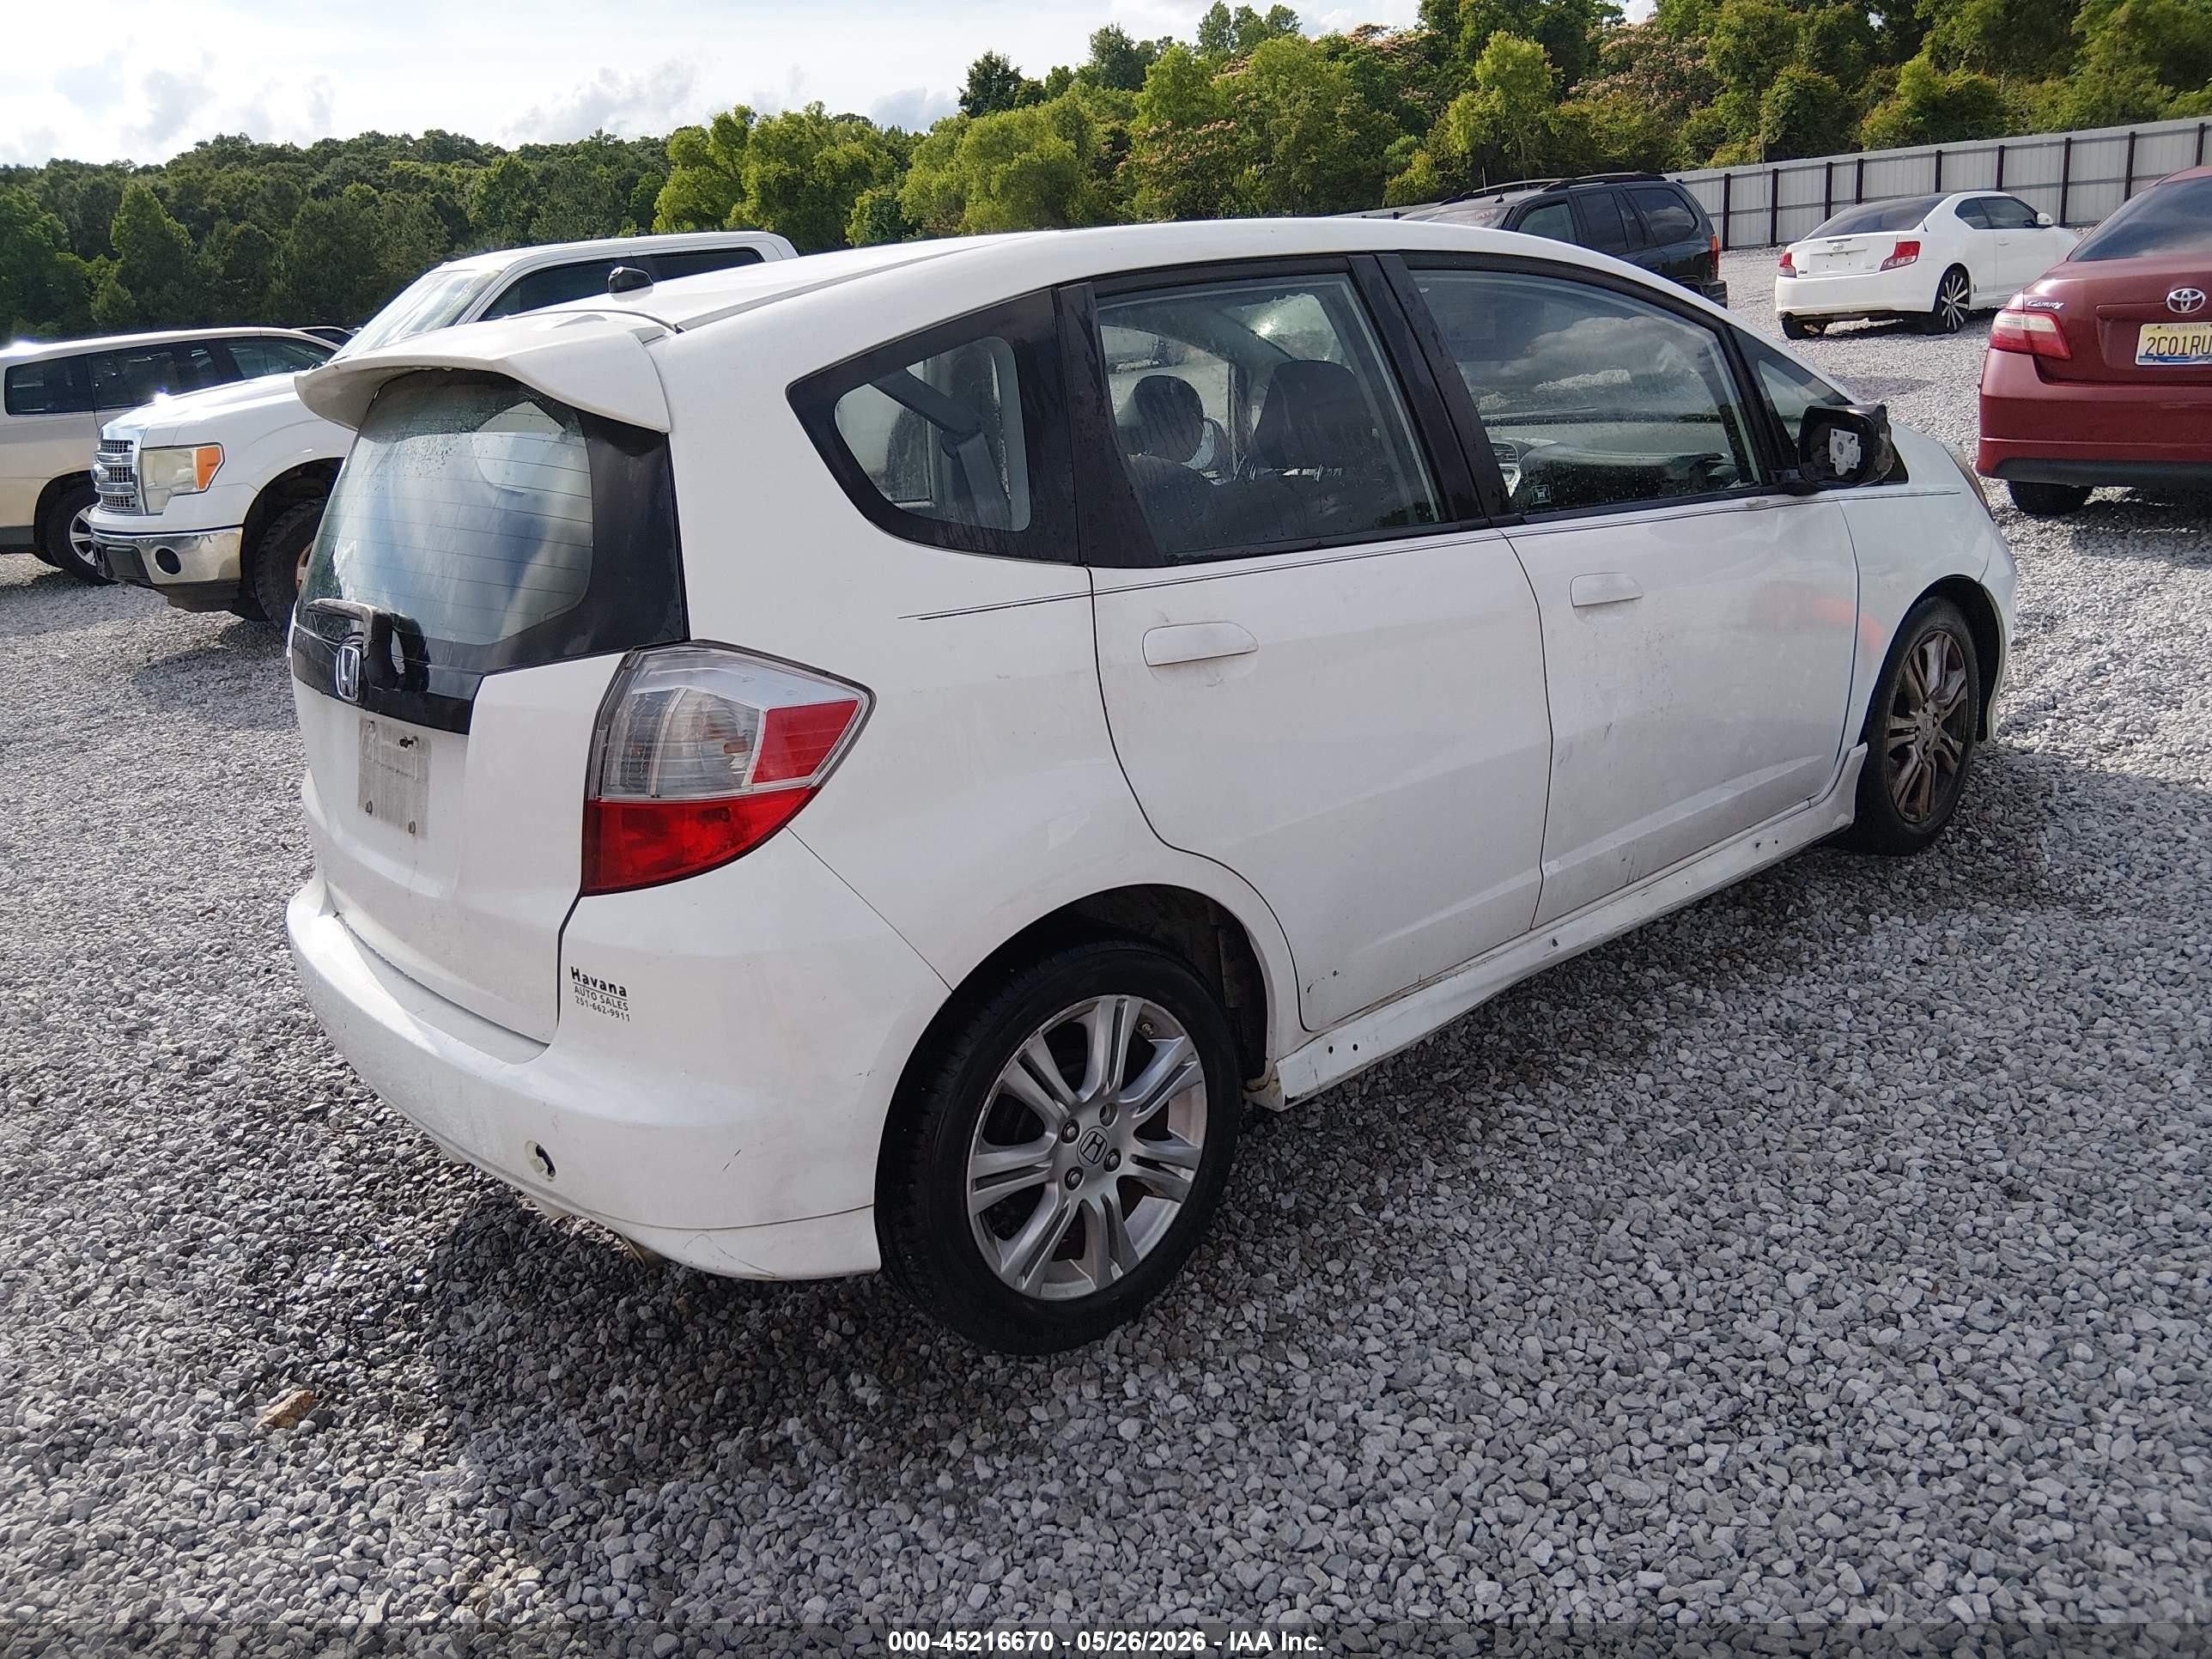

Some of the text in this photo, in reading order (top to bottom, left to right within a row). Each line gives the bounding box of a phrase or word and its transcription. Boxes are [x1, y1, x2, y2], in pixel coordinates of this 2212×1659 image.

[2146, 335, 2212, 356] 2C01RU
[570, 965, 628, 998] Havana
[574, 985, 629, 1012] AUTO SALES
[575, 995, 630, 1023] 251-662-9911
